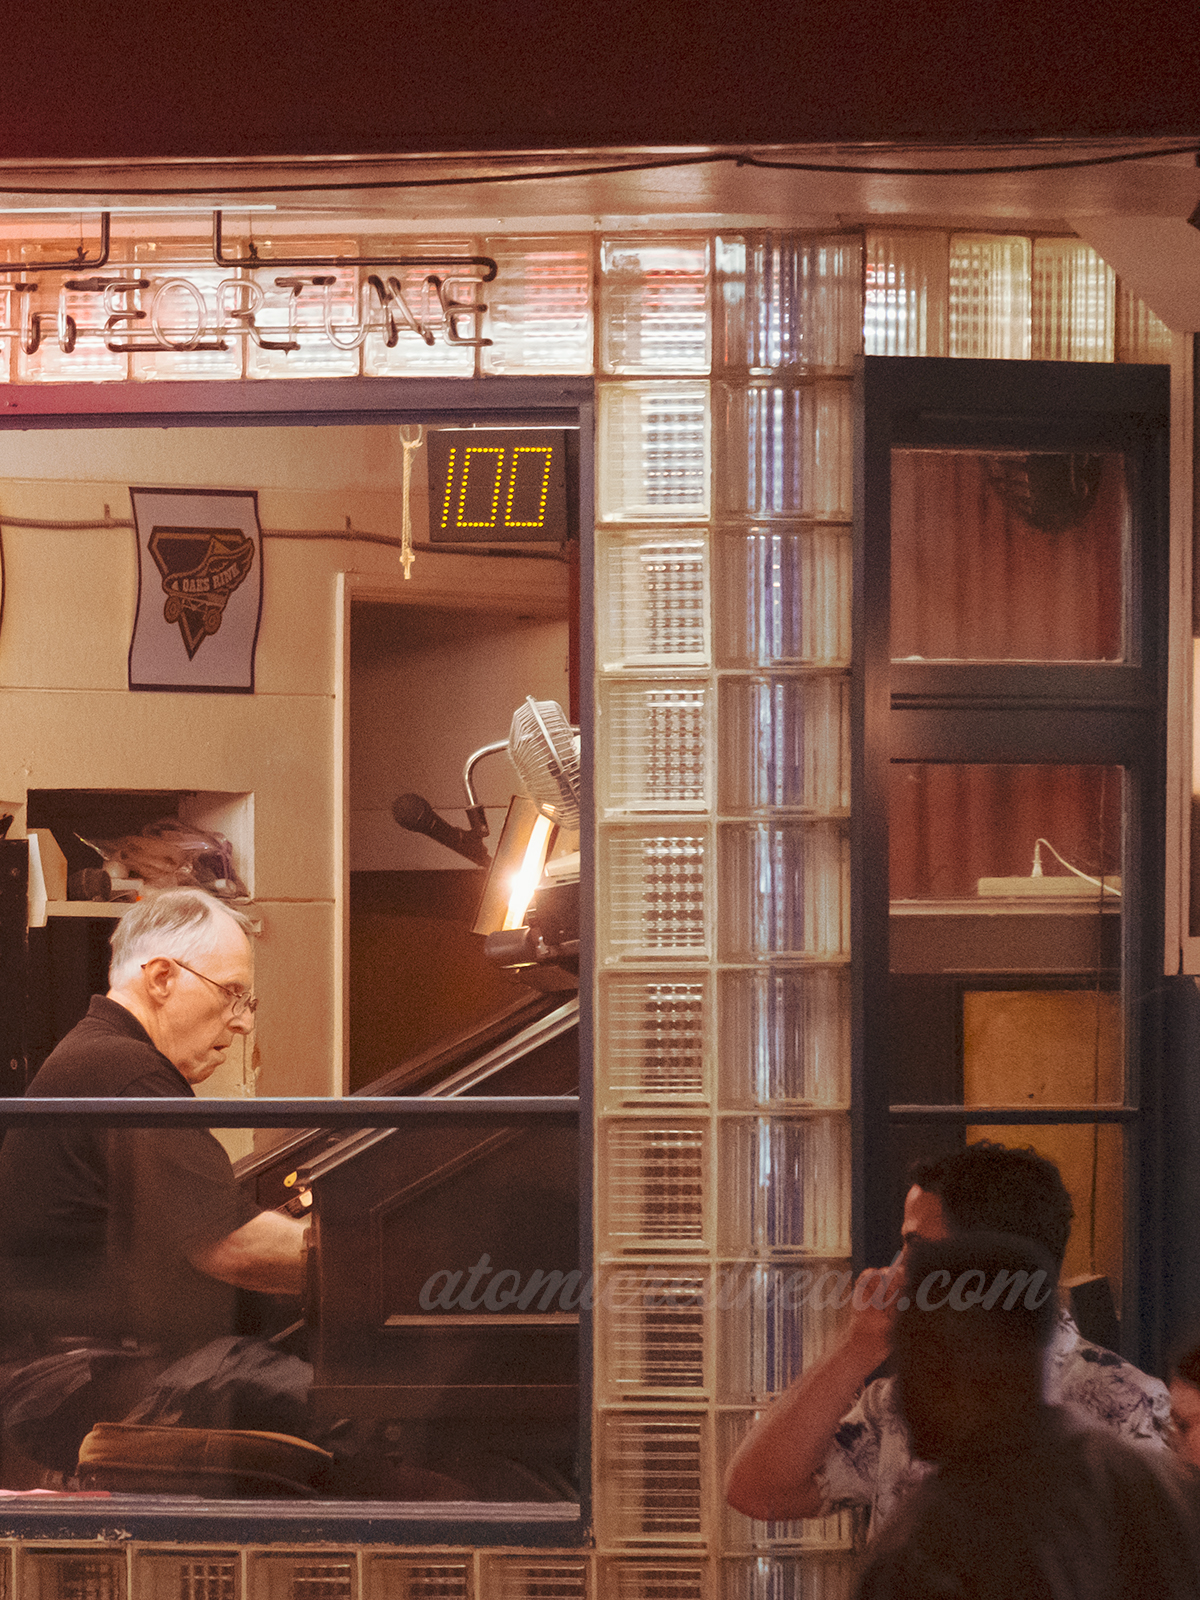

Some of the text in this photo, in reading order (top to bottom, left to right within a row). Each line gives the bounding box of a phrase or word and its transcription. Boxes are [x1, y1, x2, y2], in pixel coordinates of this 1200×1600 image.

[103, 276, 493, 354] FORTUNE
[441, 447, 552, 529] 100
[182, 562, 240, 592] OAKS RINK
